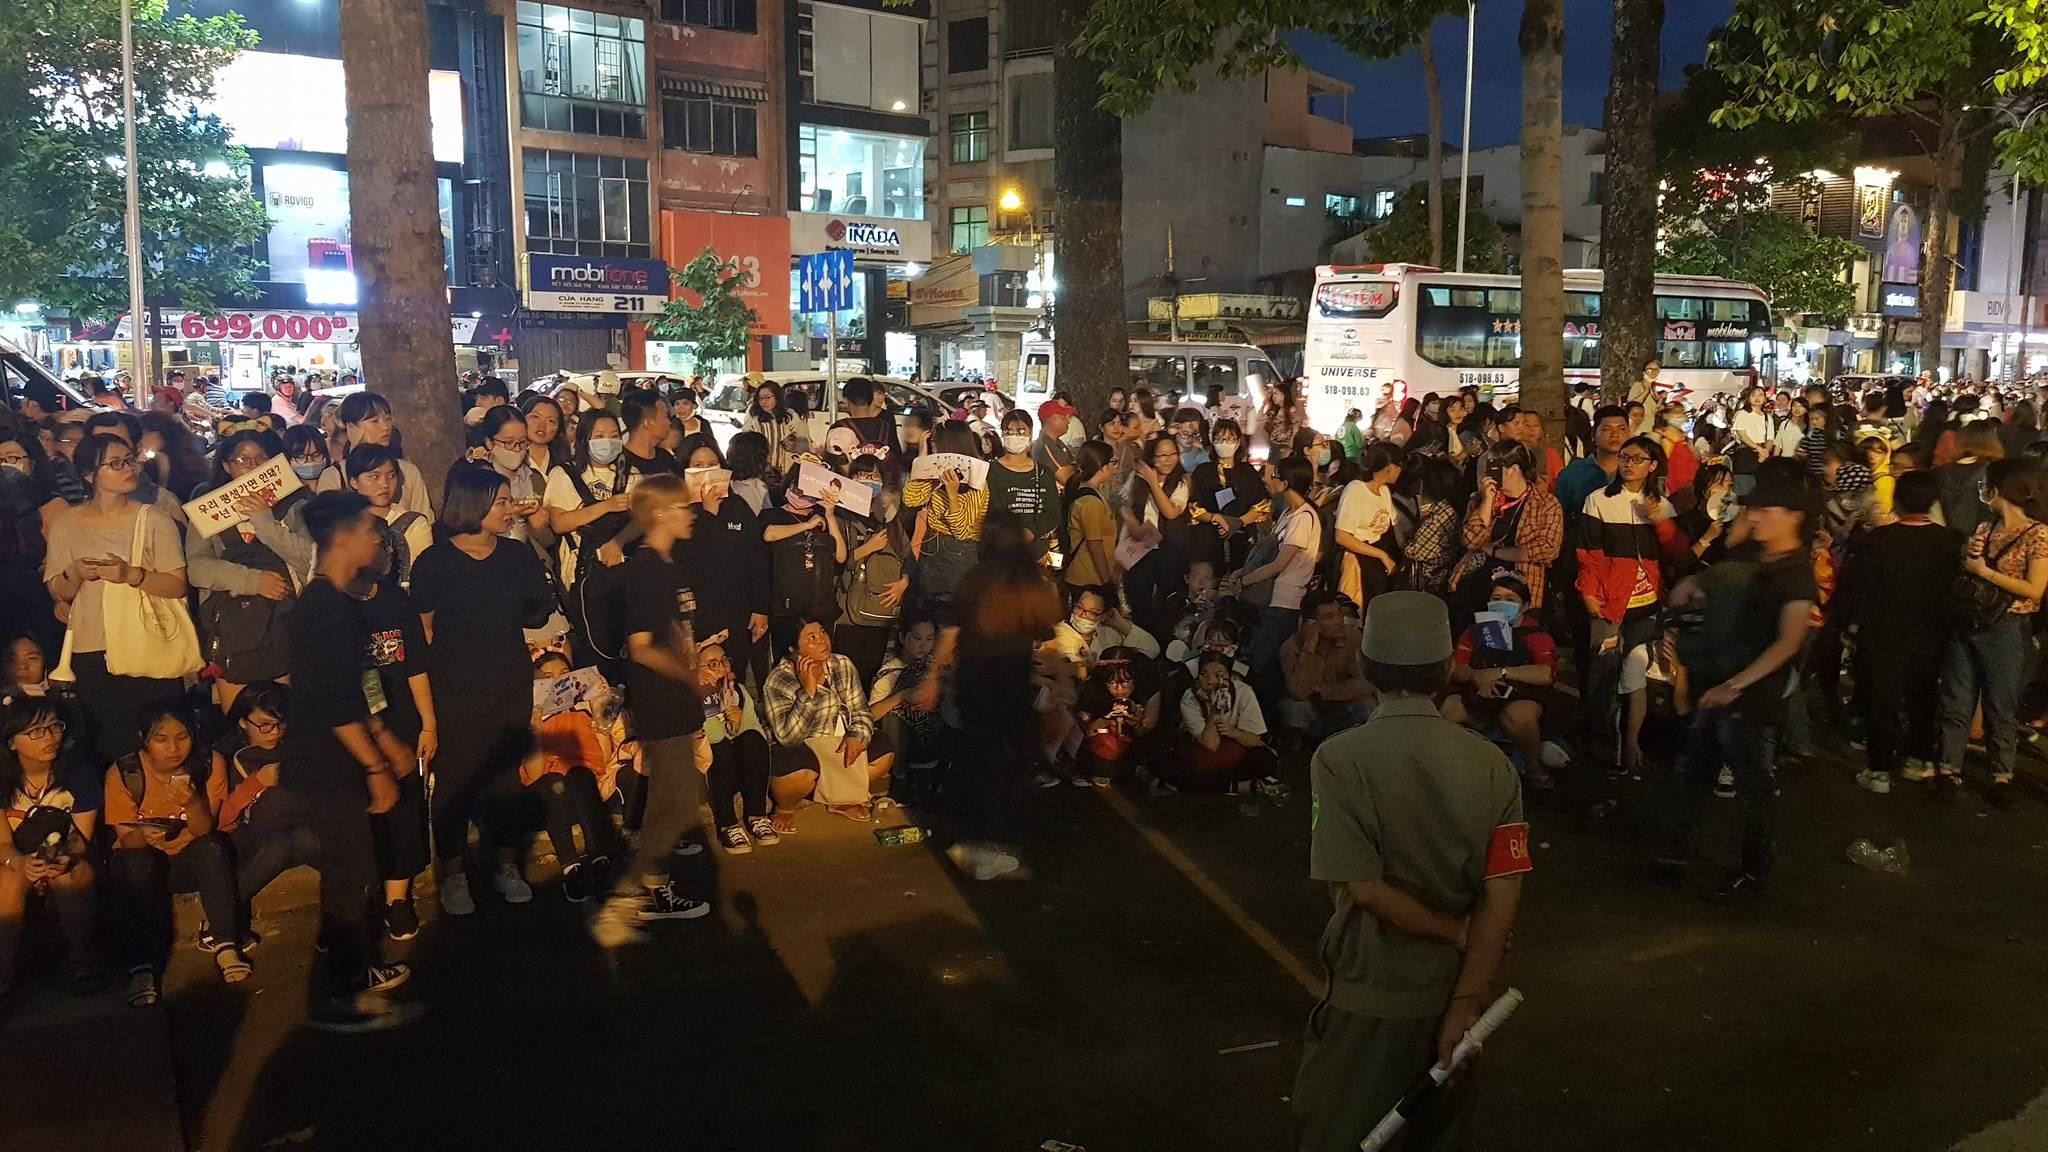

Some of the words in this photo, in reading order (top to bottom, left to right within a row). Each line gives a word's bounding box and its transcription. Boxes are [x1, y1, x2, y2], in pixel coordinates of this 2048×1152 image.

[284, 195, 314, 206] ROVIGO
[849, 228, 900, 245] INADA
[551, 262, 648, 283] mobifone
[614, 296, 645, 311] 211
[1987, 301, 2005, 316] BIDV
[1321, 367, 1378, 378] UNIVERSE
[1459, 373, 1505, 384] 51B-098.63
[1324, 385, 1370, 396] 51B-098.63
[198, 499, 219, 514] 우리
